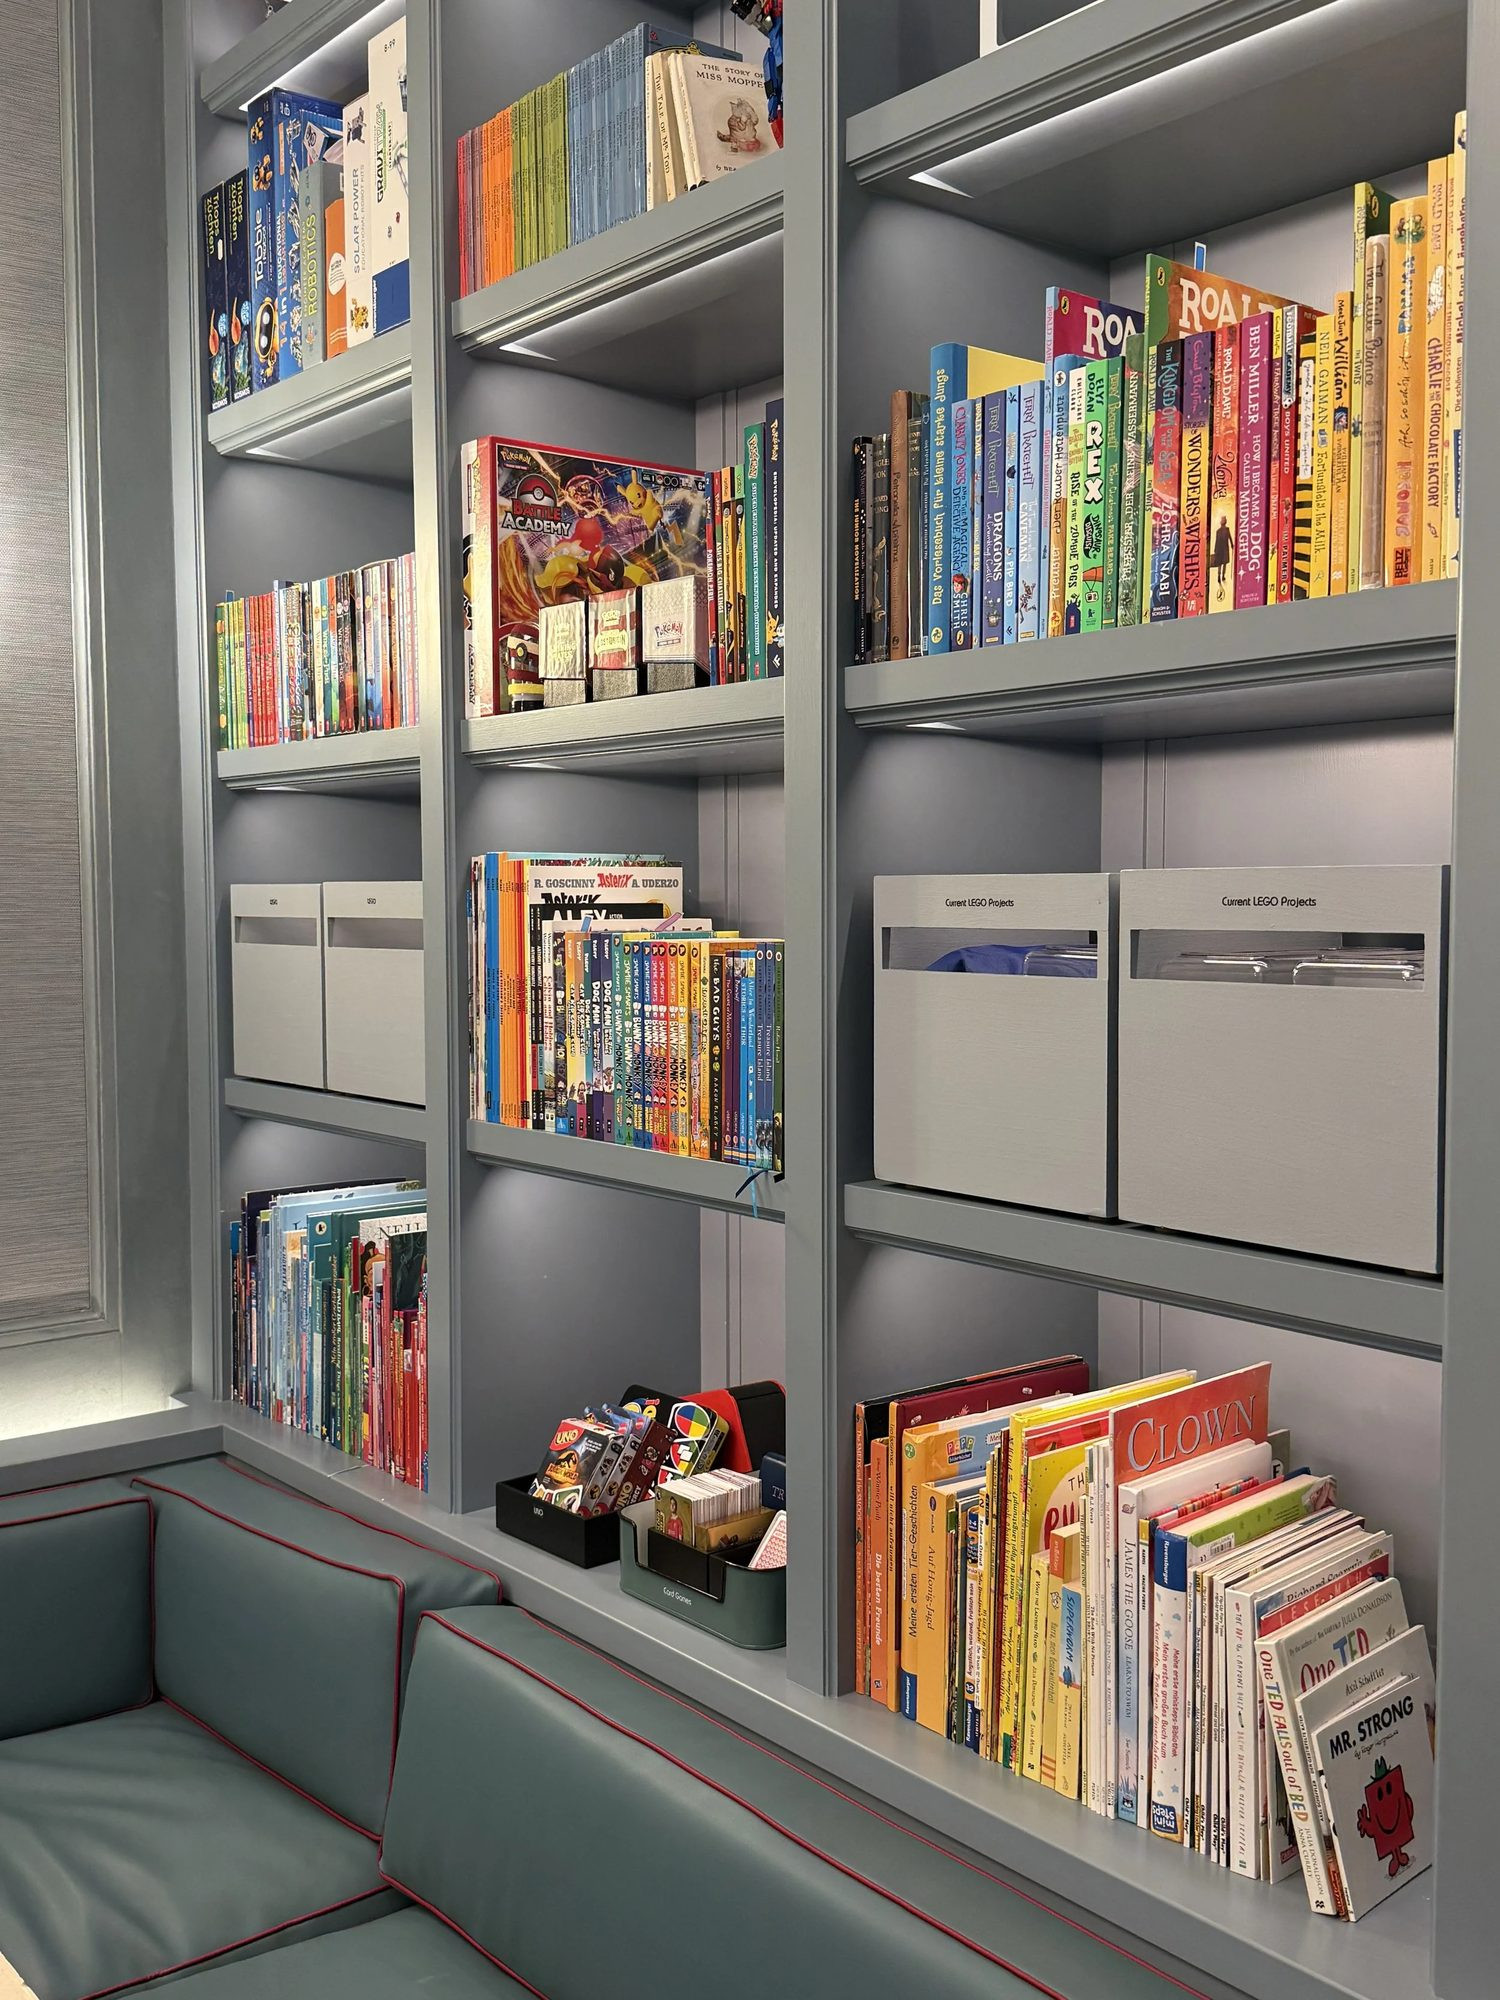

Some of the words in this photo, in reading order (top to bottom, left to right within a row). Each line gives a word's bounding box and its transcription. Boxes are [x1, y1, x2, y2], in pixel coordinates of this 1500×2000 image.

[655, 73, 663, 92] THE
[695, 71, 722, 82] MISS
[727, 75, 765, 89] MOPPE
[701, 63, 720, 73] THE
[724, 66, 749, 77] STORY
[236, 178, 244, 223] Triops
[352, 168, 360, 224] POWER
[211, 192, 220, 236] Triops
[254, 207, 264, 290] Tobbie
[306, 213, 319, 317] ROBOTICS
[353, 226, 361, 275] SOLAR
[1365, 260, 1383, 290] The
[1337, 300, 1347, 319] Meet
[1165, 347, 1174, 361] THE
[1249, 325, 1261, 359] BEN
[1320, 332, 1330, 366] NEIL
[1224, 347, 1233, 384] ROALD
[1334, 336, 1350, 400] William
[1365, 339, 1383, 387] Prince
[1428, 337, 1441, 389] CHARLIE
[935, 368, 949, 403] Jungs
[1086, 372, 1096, 413] DOLAN
[1096, 378, 1105, 405] ELYS
[1158, 363, 1180, 428] KINGDOM
[1222, 386, 1231, 419] DAHL
[1248, 362, 1260, 426] MILLER
[1318, 368, 1330, 424] GAIMAN
[988, 402, 1000, 434] TERRY
[1022, 388, 1036, 425] TERRY
[934, 406, 946, 446] starke
[1054, 395, 1066, 460] Hotzenplotz
[1427, 402, 1441, 459] CHOCOLATE
[1022, 429, 1037, 491] PRATCHETT
[1084, 420, 1104, 505] REX
[1252, 434, 1262, 462] HOW
[934, 450, 945, 486] kleine
[988, 436, 1000, 497] PRATCHETT
[1186, 432, 1202, 517] WONDERS
[1212, 450, 1235, 500] Wonka
[1243, 452, 1251, 488] CALLED
[933, 489, 946, 510] für
[1070, 472, 1081, 497] RISE
[1251, 470, 1261, 518] BECAME
[1427, 461, 1440, 508] FACTORY
[502, 511, 571, 536] ACADEMY
[511, 498, 562, 522] BATTLE
[952, 486, 962, 535] DETECTIVE
[1158, 501, 1174, 554] ZOHRA
[1239, 490, 1251, 561] MIDNIGHT
[1250, 520, 1259, 528] A
[1316, 513, 1326, 527] the
[932, 512, 944, 581] Vorlesebuch
[960, 518, 969, 568] MAGICAL
[992, 511, 1003, 581] DRAGONS
[1019, 501, 1029, 562] CAVEMAN
[1070, 526, 1080, 561] ZOMBIE
[952, 536, 961, 573] AGENCY
[1006, 560, 1014, 578] PIP
[1184, 523, 1200, 592] WISHES
[1248, 532, 1262, 573] DOG
[1069, 563, 1079, 588] PIGS
[1159, 560, 1171, 597] NABI
[931, 586, 943, 606] Das
[953, 592, 961, 630] SMITH
[960, 592, 969, 627] CHRIS
[1005, 581, 1014, 606] BIRD
[534, 879, 543, 888] R.
[545, 878, 595, 889] GOSCINNY
[641, 878, 679, 889] UDERZO
[945, 898, 967, 907] Current
[968, 898, 987, 907] LEGO
[988, 898, 1014, 909] Projects
[1222, 896, 1251, 906] Current
[1253, 896, 1278, 906] LEGO
[1280, 896, 1317, 908] Projects
[712, 958, 721, 975] the
[603, 980, 613, 1002] DOG
[711, 977, 721, 1003] BAD
[603, 1004, 612, 1026] MAN
[712, 1006, 721, 1041] GUYS
[625, 1073, 633, 1111] MONKEY
[555, 1429, 579, 1445] UNO
[1128, 1395, 1256, 1473] CLOWN
[533, 1507, 544, 1517] UNO
[908, 1484, 918, 1569] Tier-Geschichten
[875, 1552, 883, 1564] Die
[927, 1545, 937, 1565] Auf
[1123, 1538, 1137, 1579] JAMES
[1161, 1540, 1171, 1585] Ravensburger
[663, 1586, 675, 1598] Card
[675, 1591, 692, 1606] Games
[875, 1573, 883, 1602] besten
[908, 1573, 918, 1604] ersten
[1124, 1581, 1134, 1604] THE
[875, 1607, 883, 1645] Freunde
[908, 1607, 918, 1638] Meine
[1063, 1595, 1076, 1664] SUPERWORM
[1124, 1608, 1134, 1650] GOOSE
[1161, 1641, 1169, 1662] Mein
[1260, 1650, 1274, 1680] One
[1161, 1666, 1169, 1687] erstes
[1266, 1682, 1285, 1711] TED
[1161, 1715, 1169, 1738] Buch
[1273, 1714, 1292, 1750] FALLS
[1329, 1735, 1357, 1759] MR.
[1358, 1696, 1414, 1739] STRONG
[1282, 1750, 1297, 1774] out
[1288, 1776, 1302, 1793] of
[1289, 1793, 1309, 1822] BED
